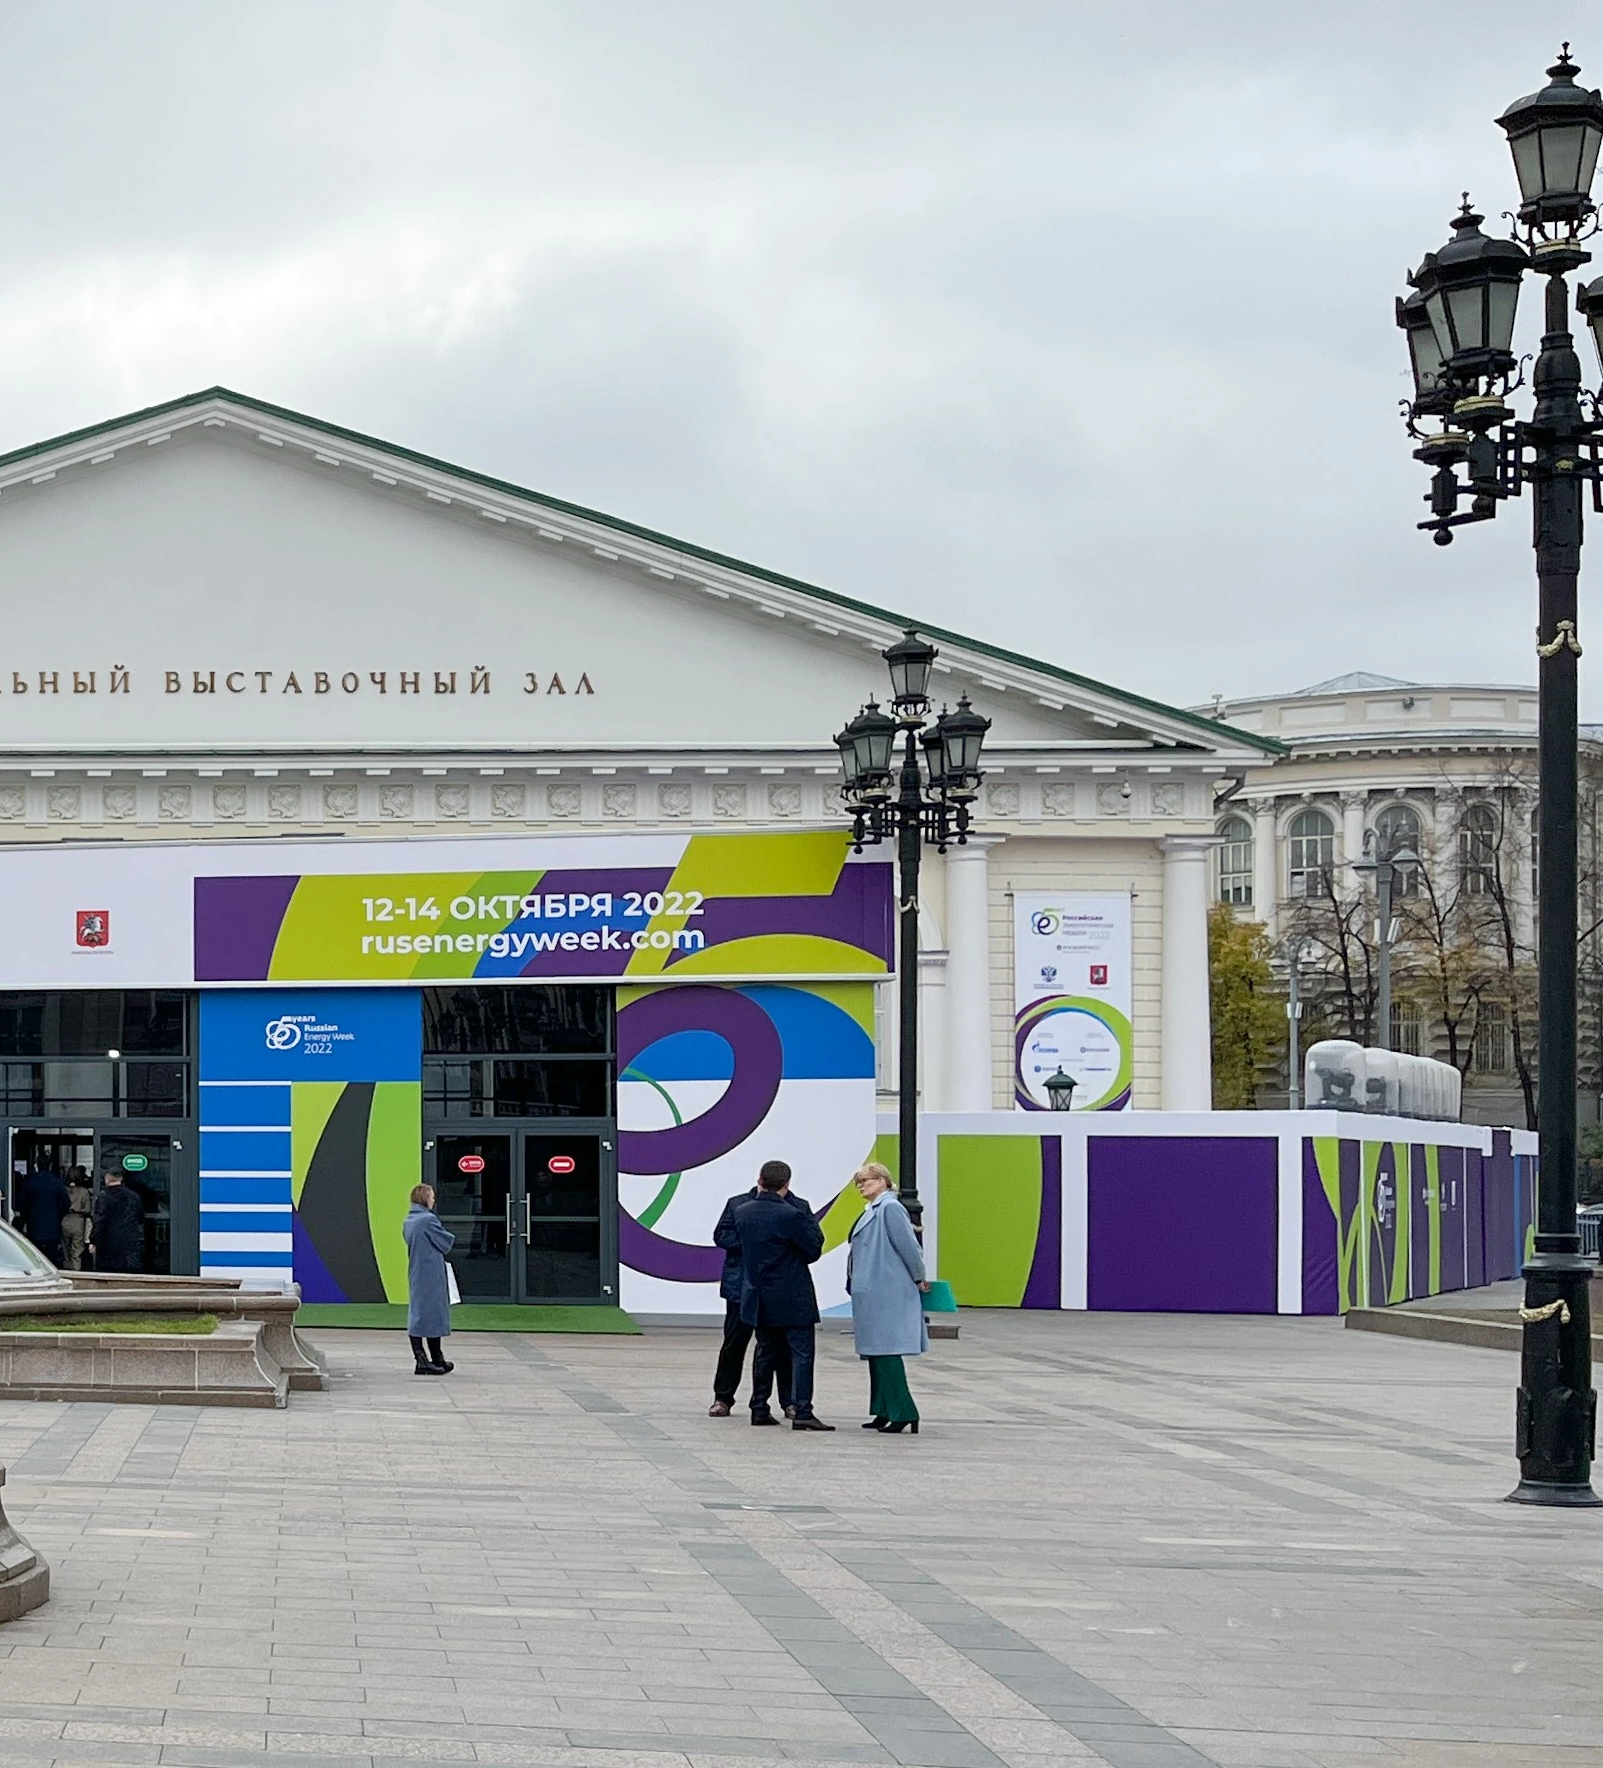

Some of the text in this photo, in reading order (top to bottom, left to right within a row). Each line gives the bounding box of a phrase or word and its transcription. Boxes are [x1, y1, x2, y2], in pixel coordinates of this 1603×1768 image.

[164, 664, 491, 694] ВЫСТАВОЧНЫЙ
[523, 671, 596, 694] ЗАЛ
[361, 891, 705, 923] 12-14 ОКТЯБРЯ 2022
[361, 926, 705, 958] rusenergyweek.com
[303, 1024, 339, 1032] Russian
[303, 1042, 333, 1054] 2022
